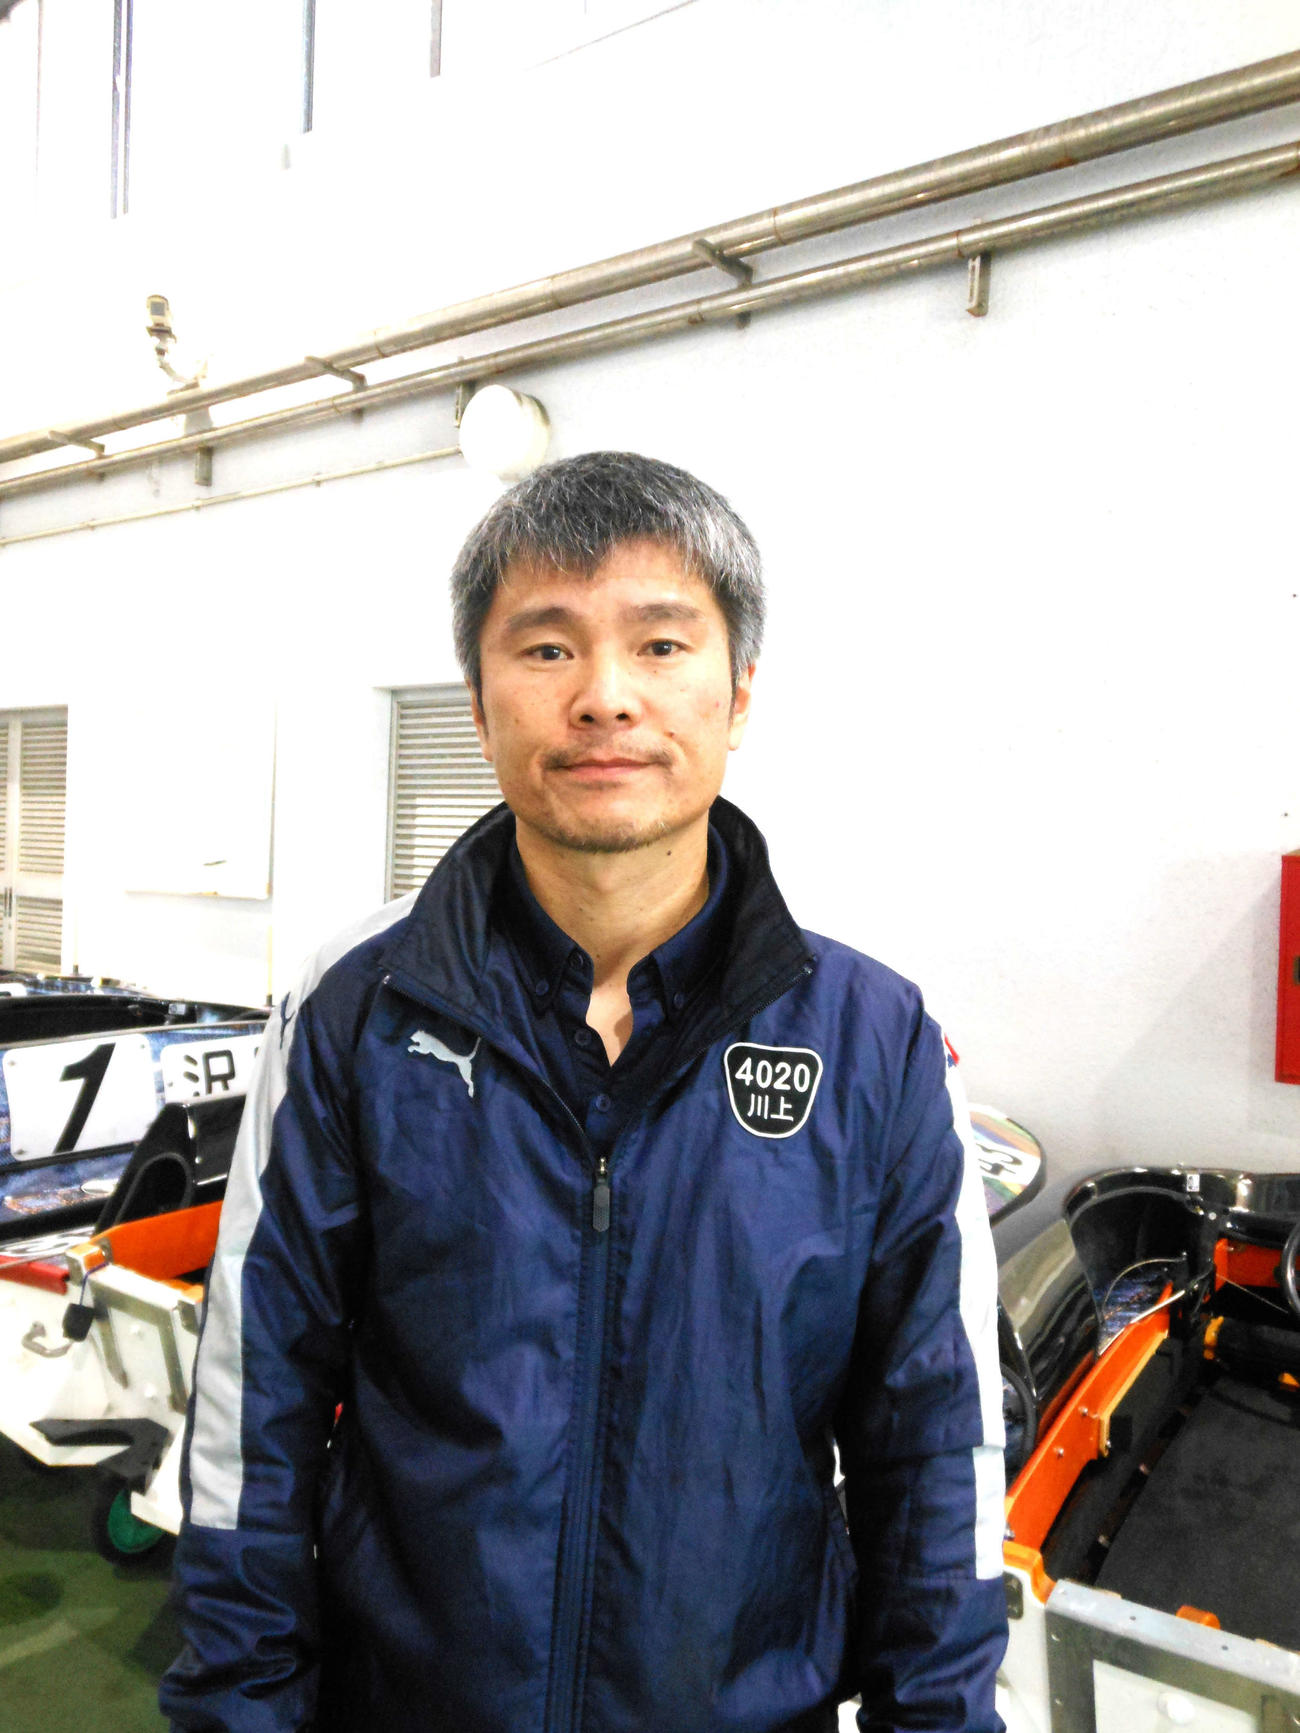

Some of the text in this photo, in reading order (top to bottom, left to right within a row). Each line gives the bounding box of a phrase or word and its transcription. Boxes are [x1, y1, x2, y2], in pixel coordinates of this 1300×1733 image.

[735, 1057, 811, 1092] 4020
[53, 1042, 116, 1154] 1
[747, 1093, 794, 1121] 川上
